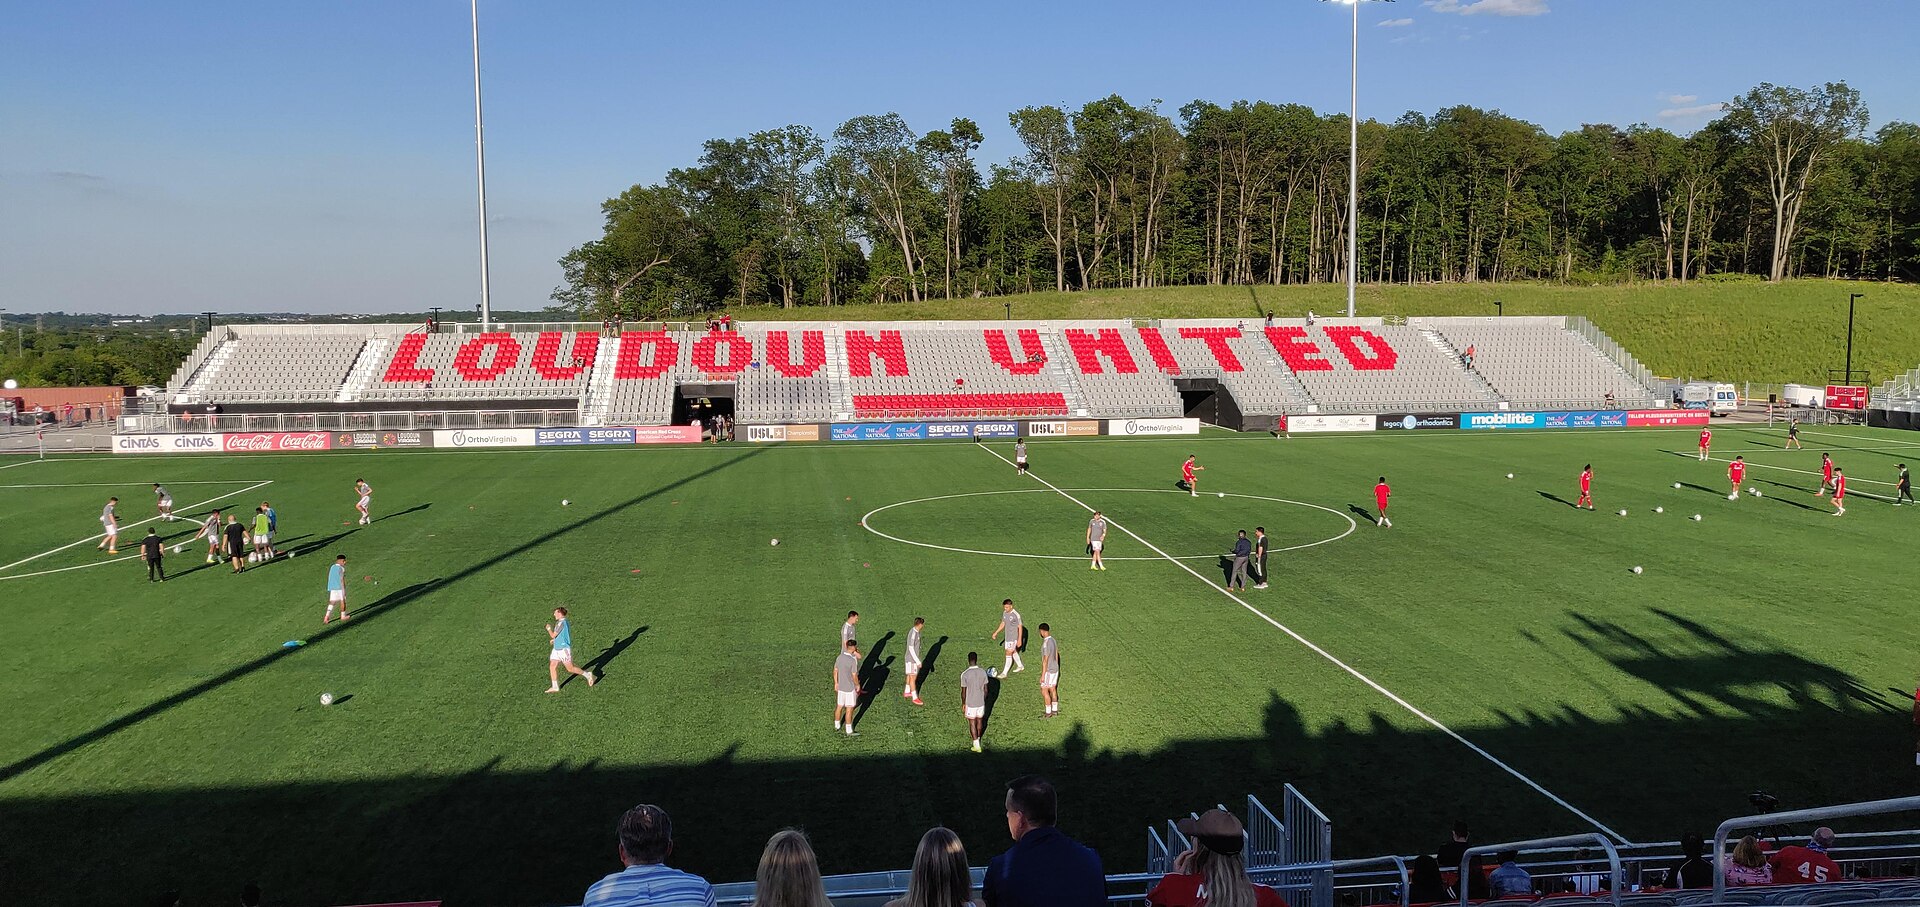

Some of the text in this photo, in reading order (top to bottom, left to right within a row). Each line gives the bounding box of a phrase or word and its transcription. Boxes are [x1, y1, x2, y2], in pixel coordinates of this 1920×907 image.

[383, 326, 1398, 383] LOUDOUN UNITED
[1472, 413, 1534, 424] mobilitie
[928, 425, 968, 433] SEGRA
[1384, 420, 1403, 428] legacy
[539, 431, 581, 439] SEGRA
[588, 430, 631, 438] SEGRA
[226, 434, 275, 450] Coca-Cola
[280, 434, 327, 449] Coca-Cola
[467, 435, 518, 444] OrthoVirginia
[1798, 862, 1828, 882] 45
